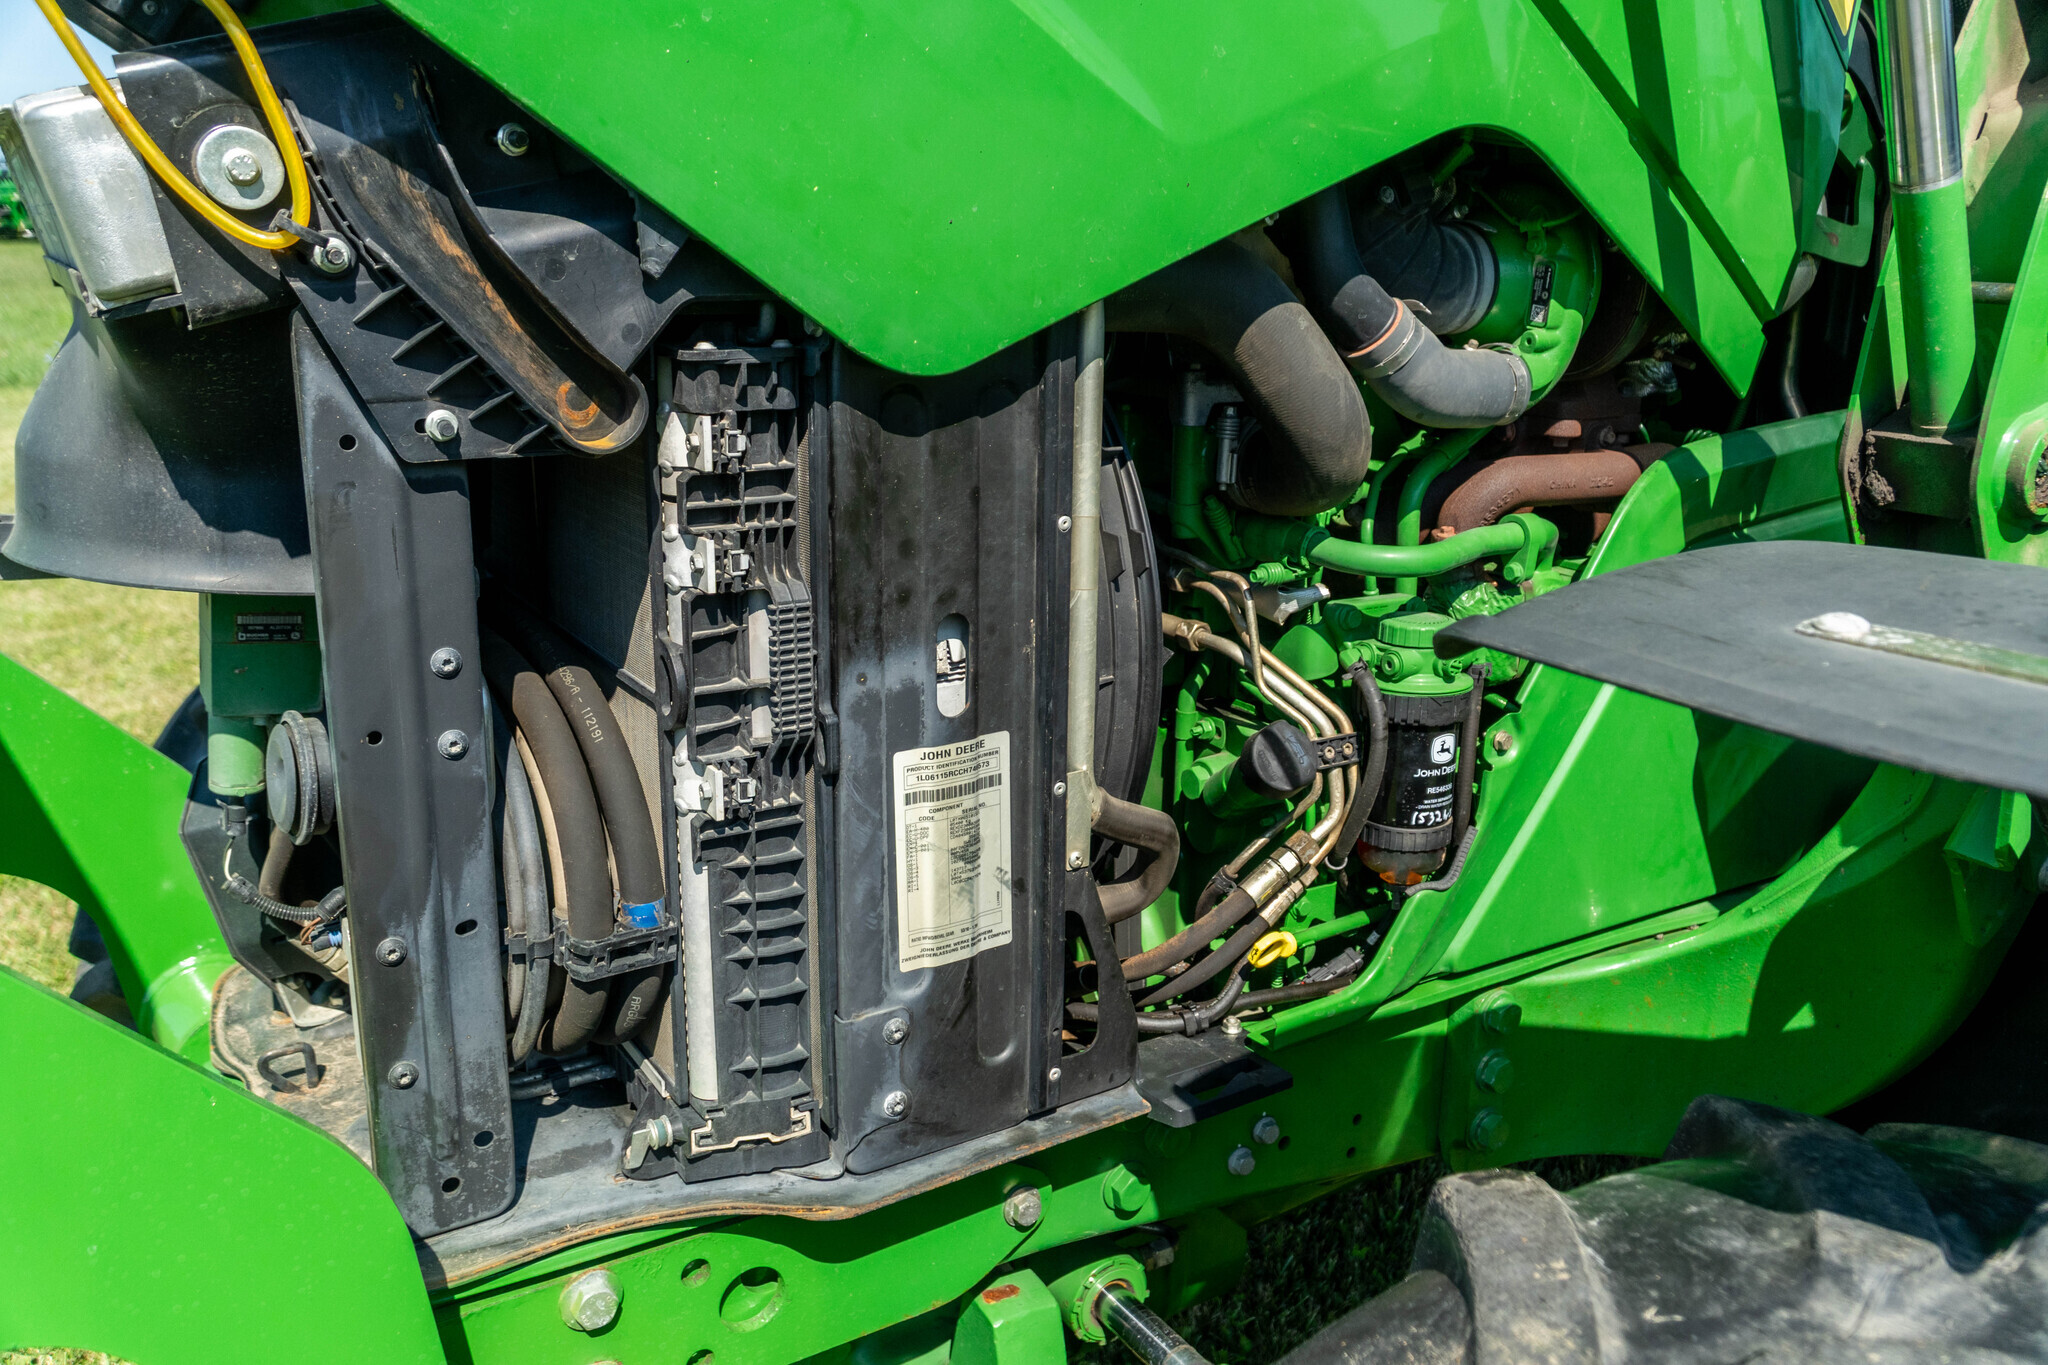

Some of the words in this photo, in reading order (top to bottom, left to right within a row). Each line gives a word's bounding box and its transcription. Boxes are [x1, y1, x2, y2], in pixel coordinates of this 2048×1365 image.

[581, 706, 604, 744] 112191
[920, 749, 951, 761] JOHN
[956, 739, 986, 756] DEERE
[906, 765, 934, 773] PRODUCT
[936, 755, 978, 770] IDENTIFICATION
[1413, 769, 1441, 778] JOHN
[929, 802, 964, 814] COMPONENT
[935, 943, 952, 951] DEERE
[953, 938, 970, 947] WERKE
[960, 943, 970, 951] DER
[987, 930, 1012, 940] COMPANY
